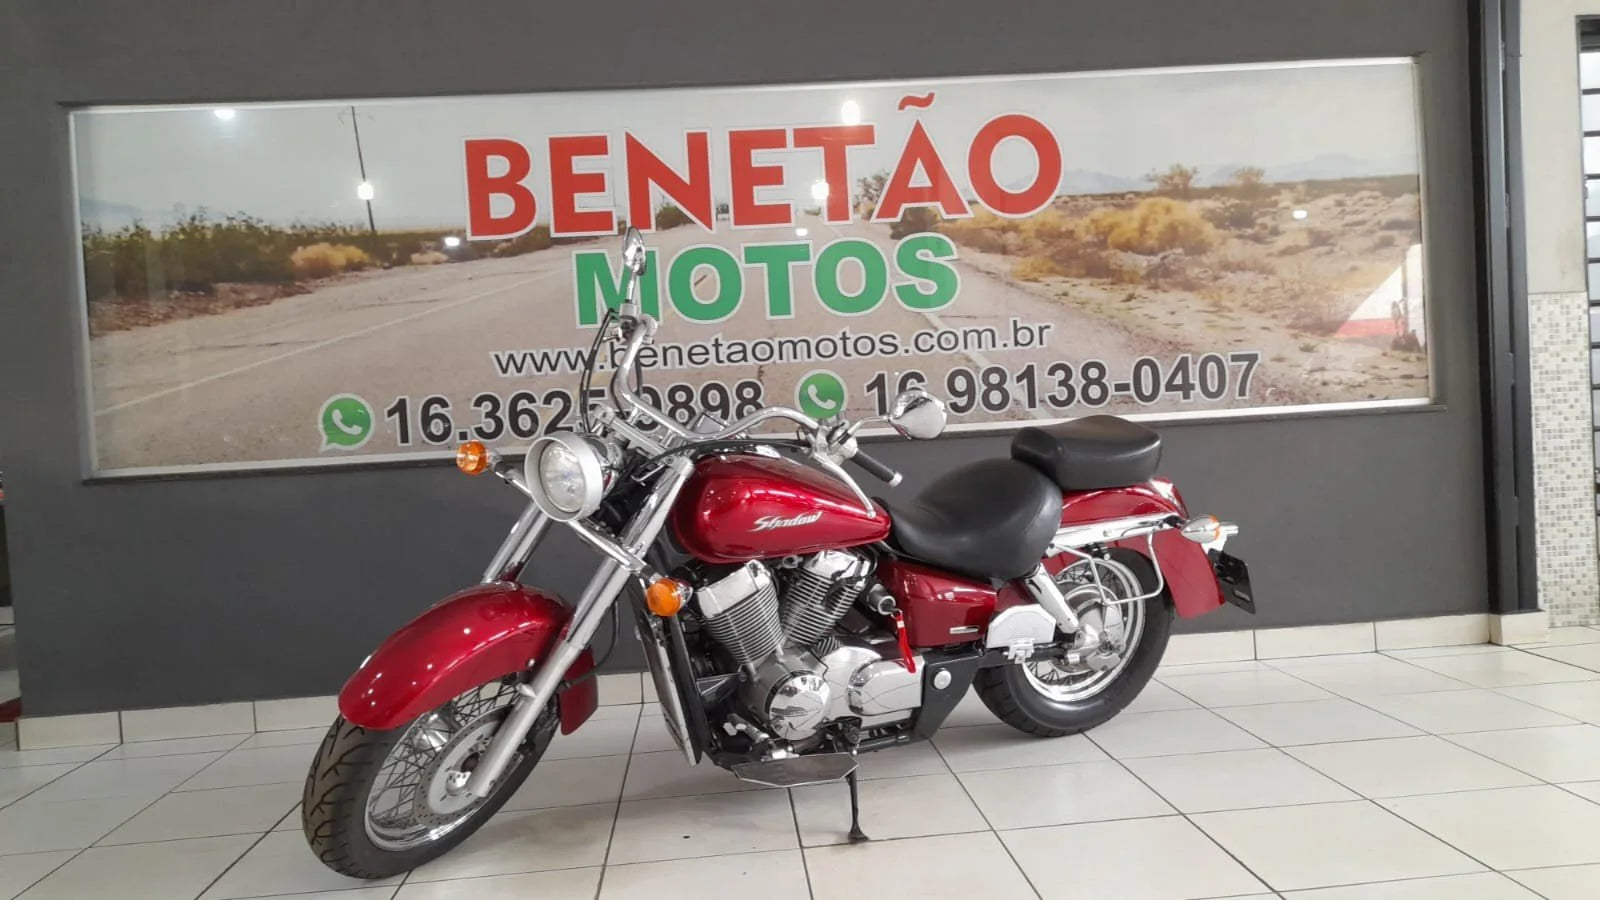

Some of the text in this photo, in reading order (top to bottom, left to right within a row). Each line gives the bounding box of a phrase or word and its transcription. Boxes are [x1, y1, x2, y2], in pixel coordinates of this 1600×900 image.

[464, 92, 1062, 237] BENETÃO
[575, 234, 959, 325] MOTOS
[494, 320, 1051, 374] www.benetaomotos.com.br
[866, 353, 1259, 416] 1698138-0407
[745, 510, 822, 532] Shadow
